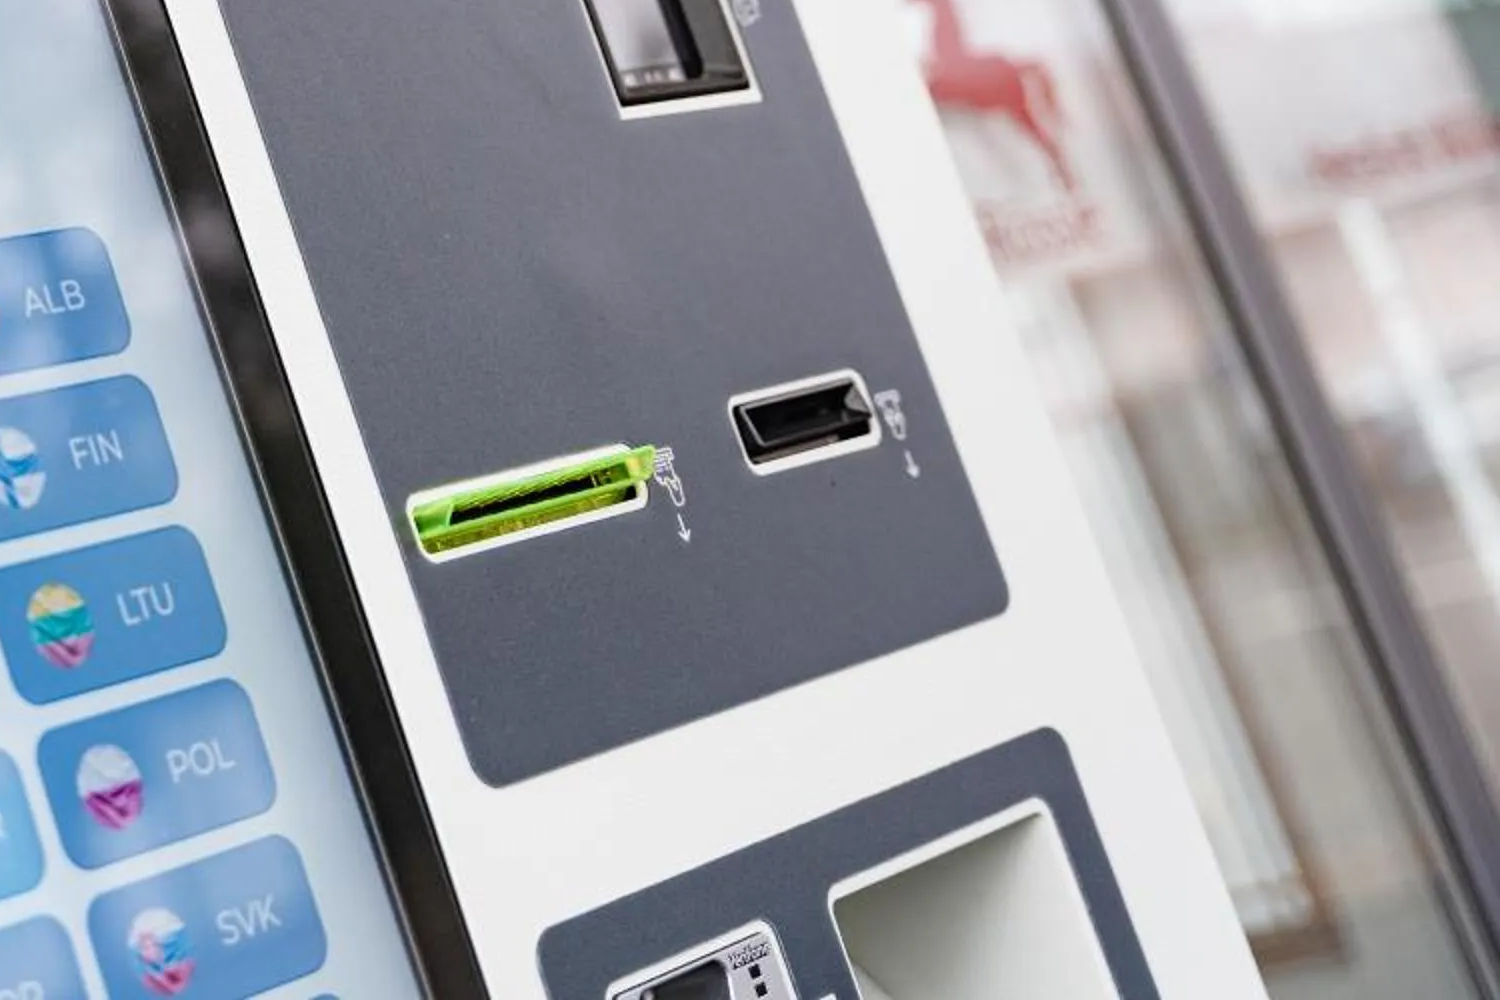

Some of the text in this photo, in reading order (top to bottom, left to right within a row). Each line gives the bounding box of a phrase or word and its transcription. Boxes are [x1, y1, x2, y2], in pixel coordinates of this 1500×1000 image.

[22, 279, 85, 320] ALB
[69, 430, 123, 470] FIN
[116, 582, 174, 628] LTU
[165, 734, 235, 783] POL
[214, 895, 280, 943] SVK
